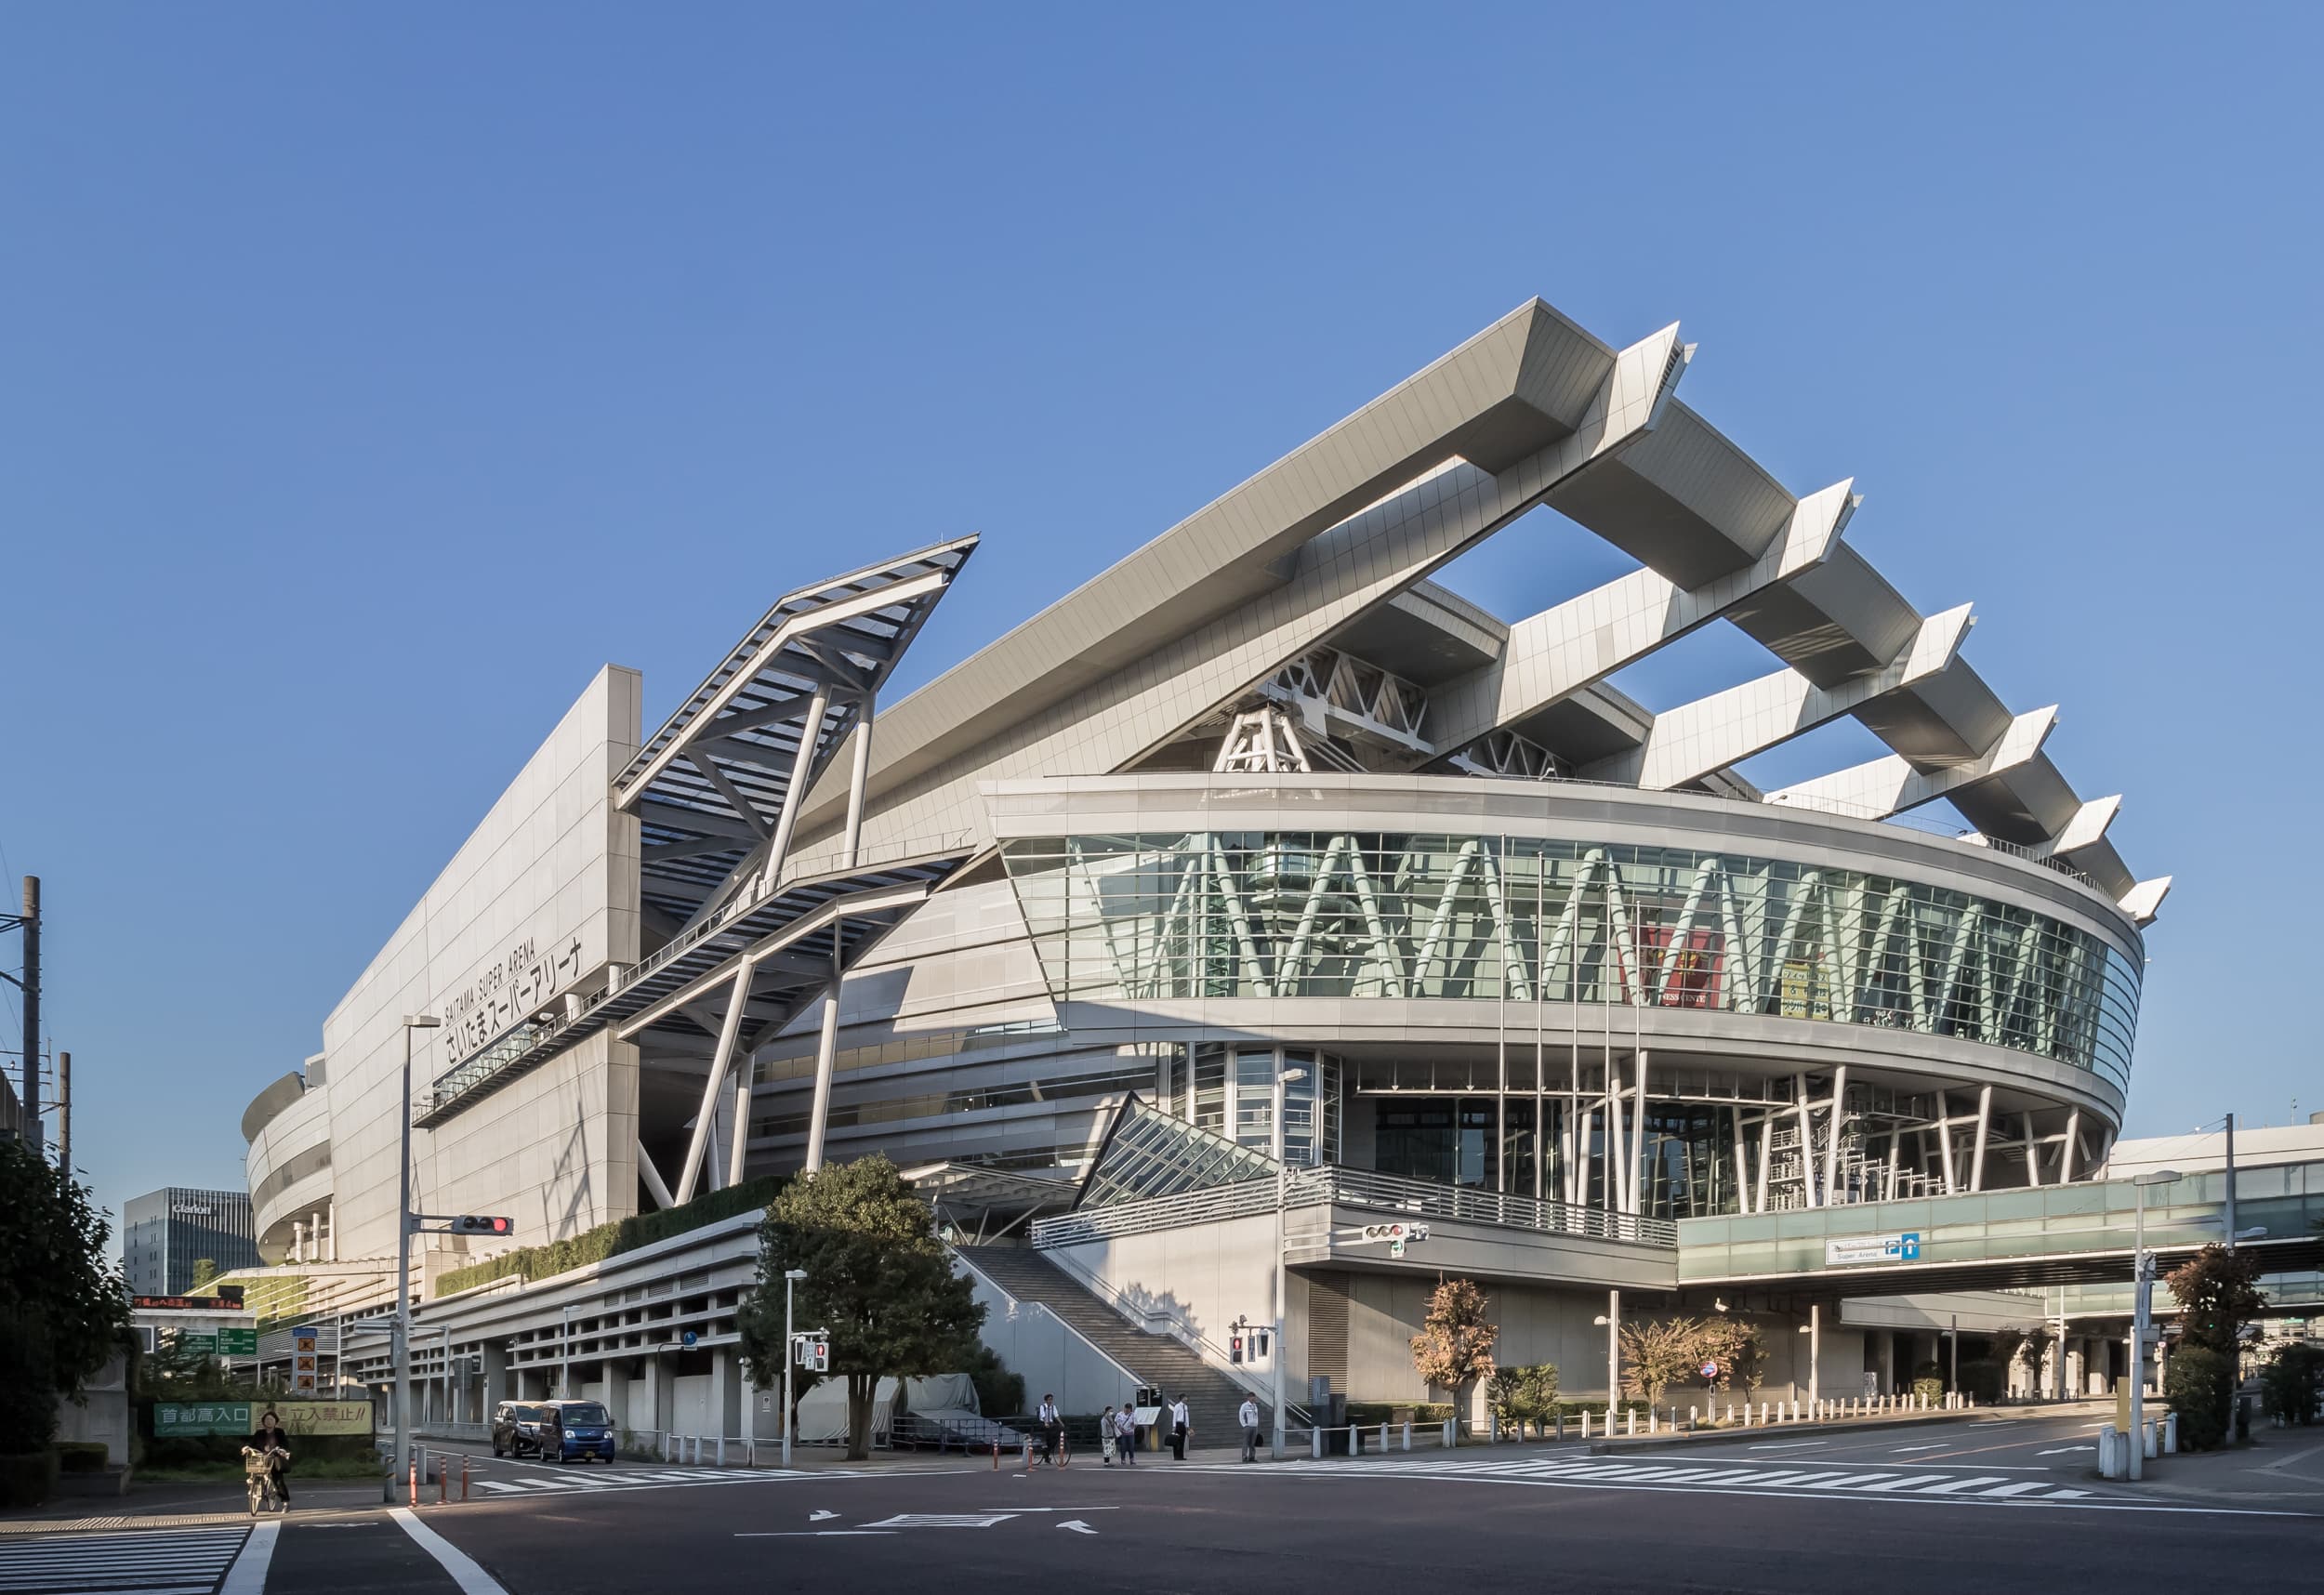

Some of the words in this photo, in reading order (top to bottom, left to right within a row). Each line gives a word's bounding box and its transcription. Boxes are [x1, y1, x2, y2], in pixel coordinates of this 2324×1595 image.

[446, 986, 475, 1027] SAITAMA
[479, 962, 503, 1001] SUPER
[508, 937, 535, 979] ARENA
[446, 936, 581, 1064] さいたまスーパーアリーナ
[174, 1204, 211, 1215] Clarion
[161, 1407, 249, 1424] 首都高入口
